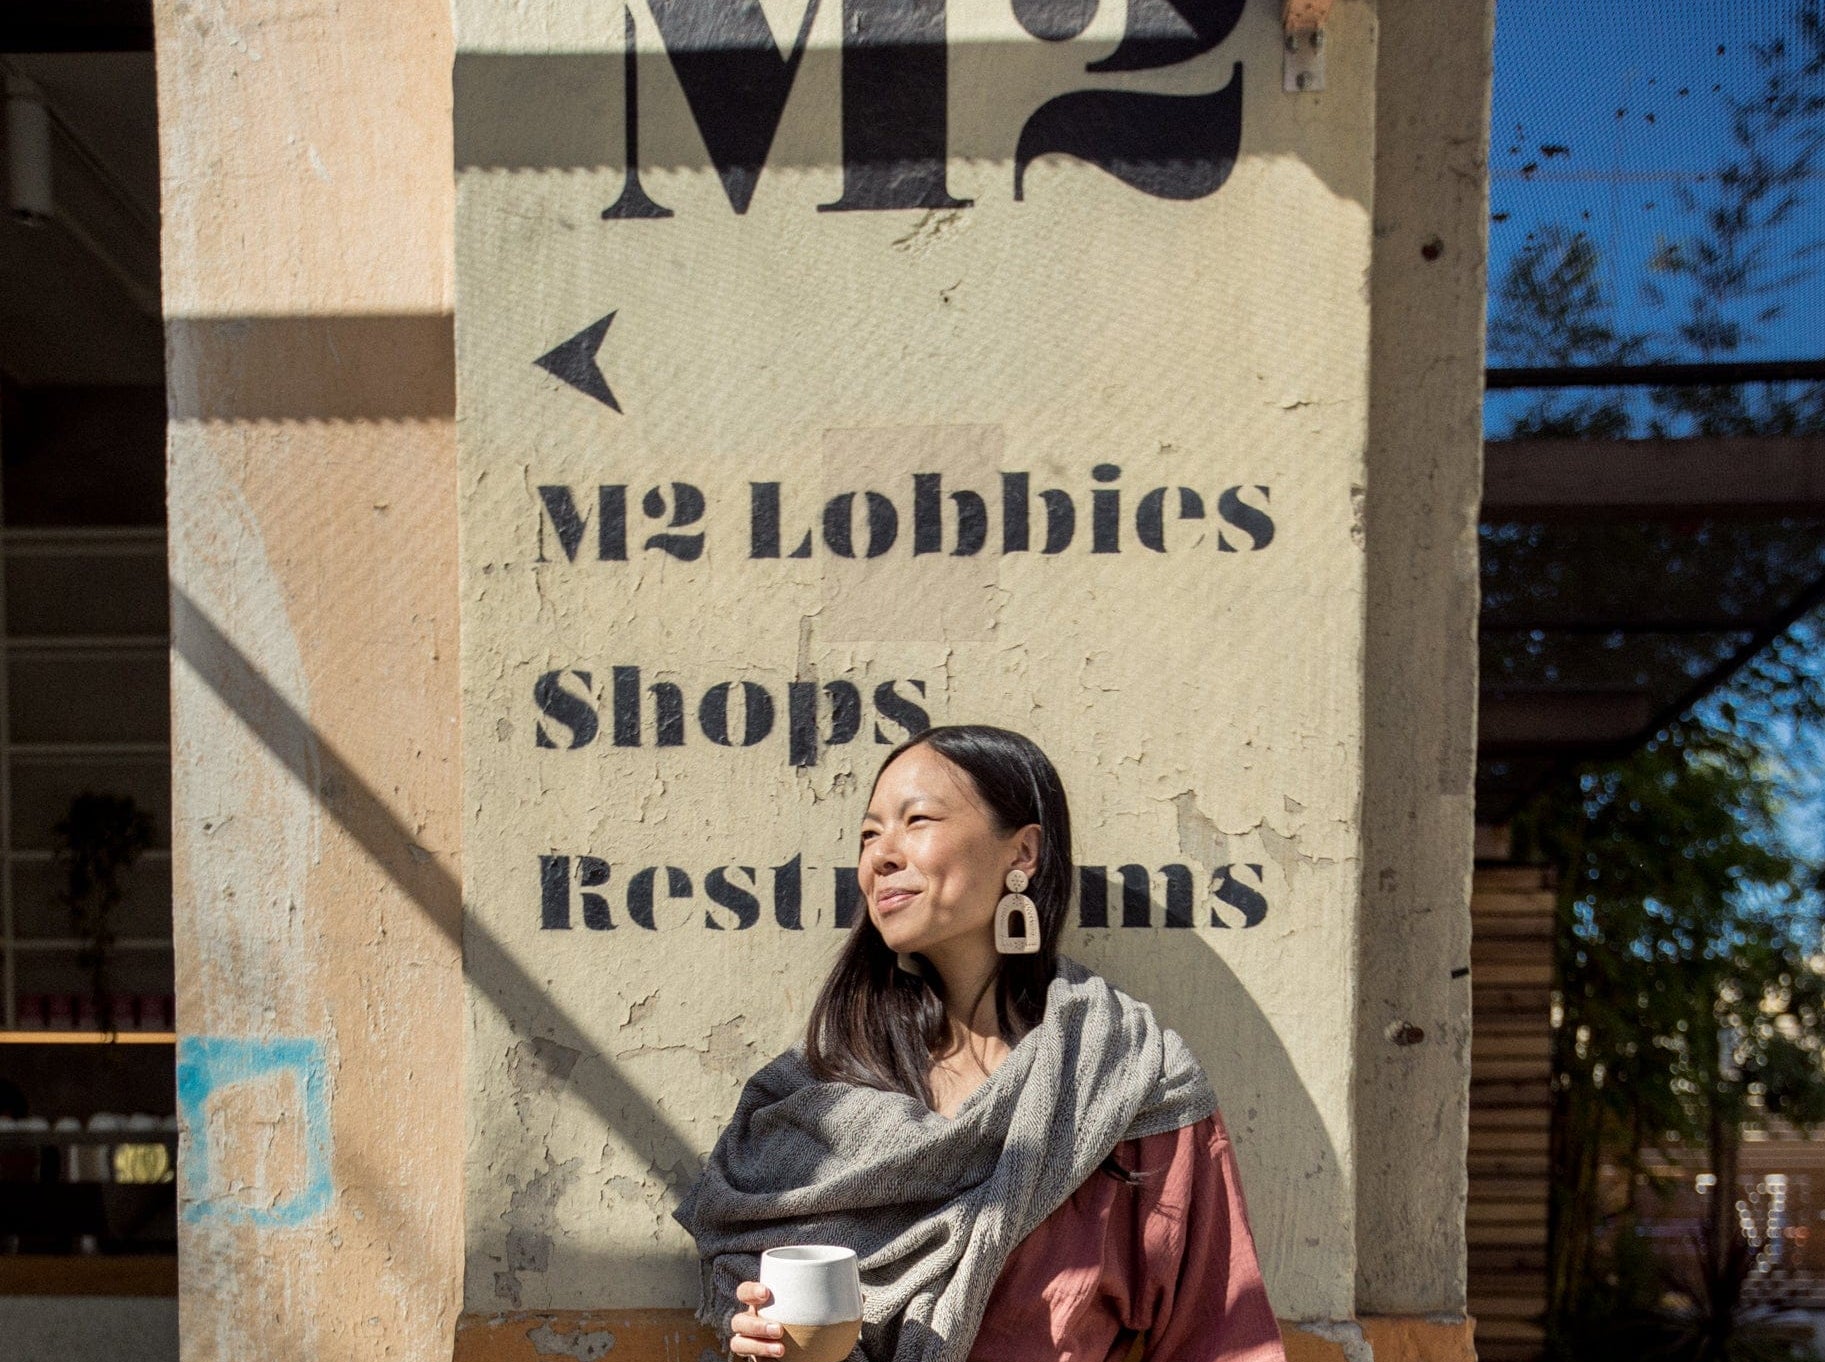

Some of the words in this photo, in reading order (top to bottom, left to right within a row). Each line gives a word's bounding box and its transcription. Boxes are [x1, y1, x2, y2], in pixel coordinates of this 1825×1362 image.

[602, 0, 1249, 219] M2
[535, 481, 706, 565] M2
[749, 463, 1276, 560] Lobbies
[533, 665, 931, 767] Shops
[538, 851, 1269, 932] Restms
